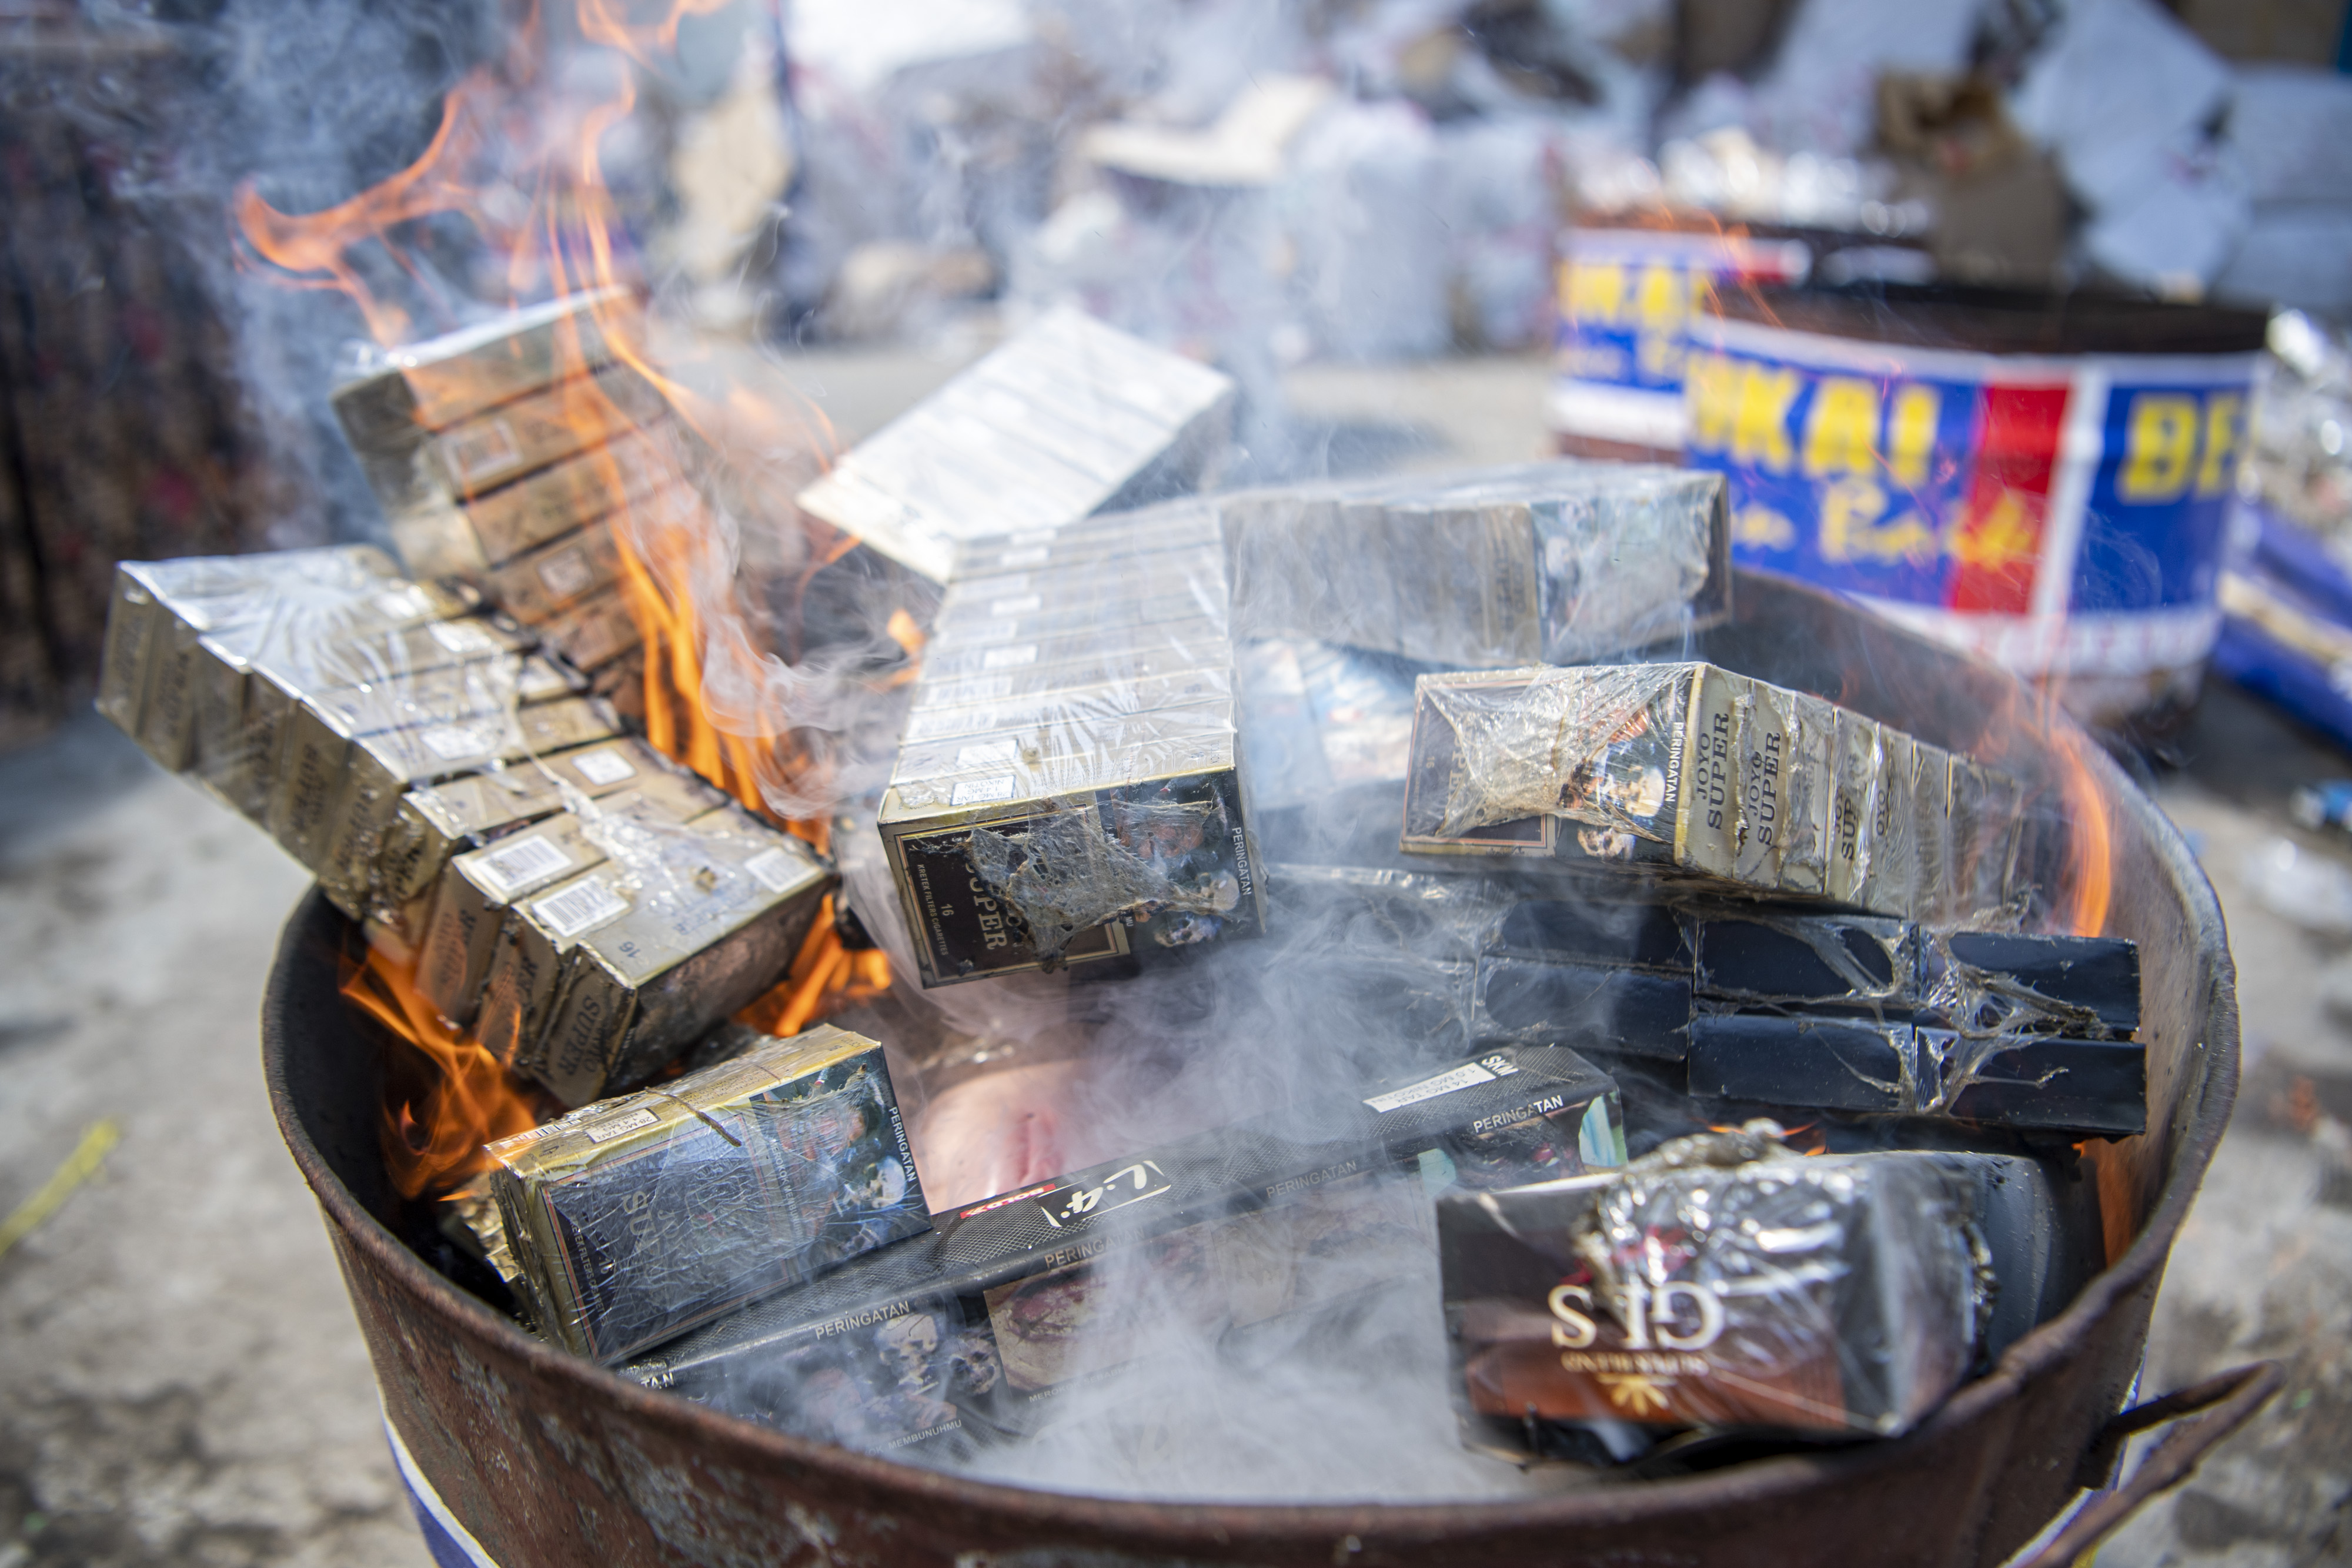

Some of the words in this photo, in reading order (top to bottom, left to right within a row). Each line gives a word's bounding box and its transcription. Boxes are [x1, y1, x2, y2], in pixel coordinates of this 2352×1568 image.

[1665, 721, 1684, 803] PERINGATAN
[1695, 733, 1710, 800] JOYO
[1706, 713, 1730, 830] SUPER
[1748, 751, 1763, 816] JOYO
[1758, 732, 1782, 847] SUPER
[1835, 791, 1845, 835] JOY
[1840, 798, 1856, 861] SUP
[1232, 827, 1252, 895] PERINGATAN
[917, 864, 930, 891] KRETEK
[924, 891, 937, 917] FILTERS
[932, 917, 948, 956] CIGARETTES
[940, 902, 954, 917] 16
[617, 937, 643, 962] 16
[557, 995, 600, 1076] SUPER
[1481, 1054, 1519, 1076] SKM
[888, 1106, 916, 1182] PERINGATAN
[1474, 1095, 1563, 1134] PERINGATAN
[985, 1187, 1045, 1209] BOLD
[1266, 1161, 1358, 1199] PERINGATAN
[815, 1300, 910, 1340] PERINGATAN
[886, 1419, 963, 1450] MEMBUNUHMU
